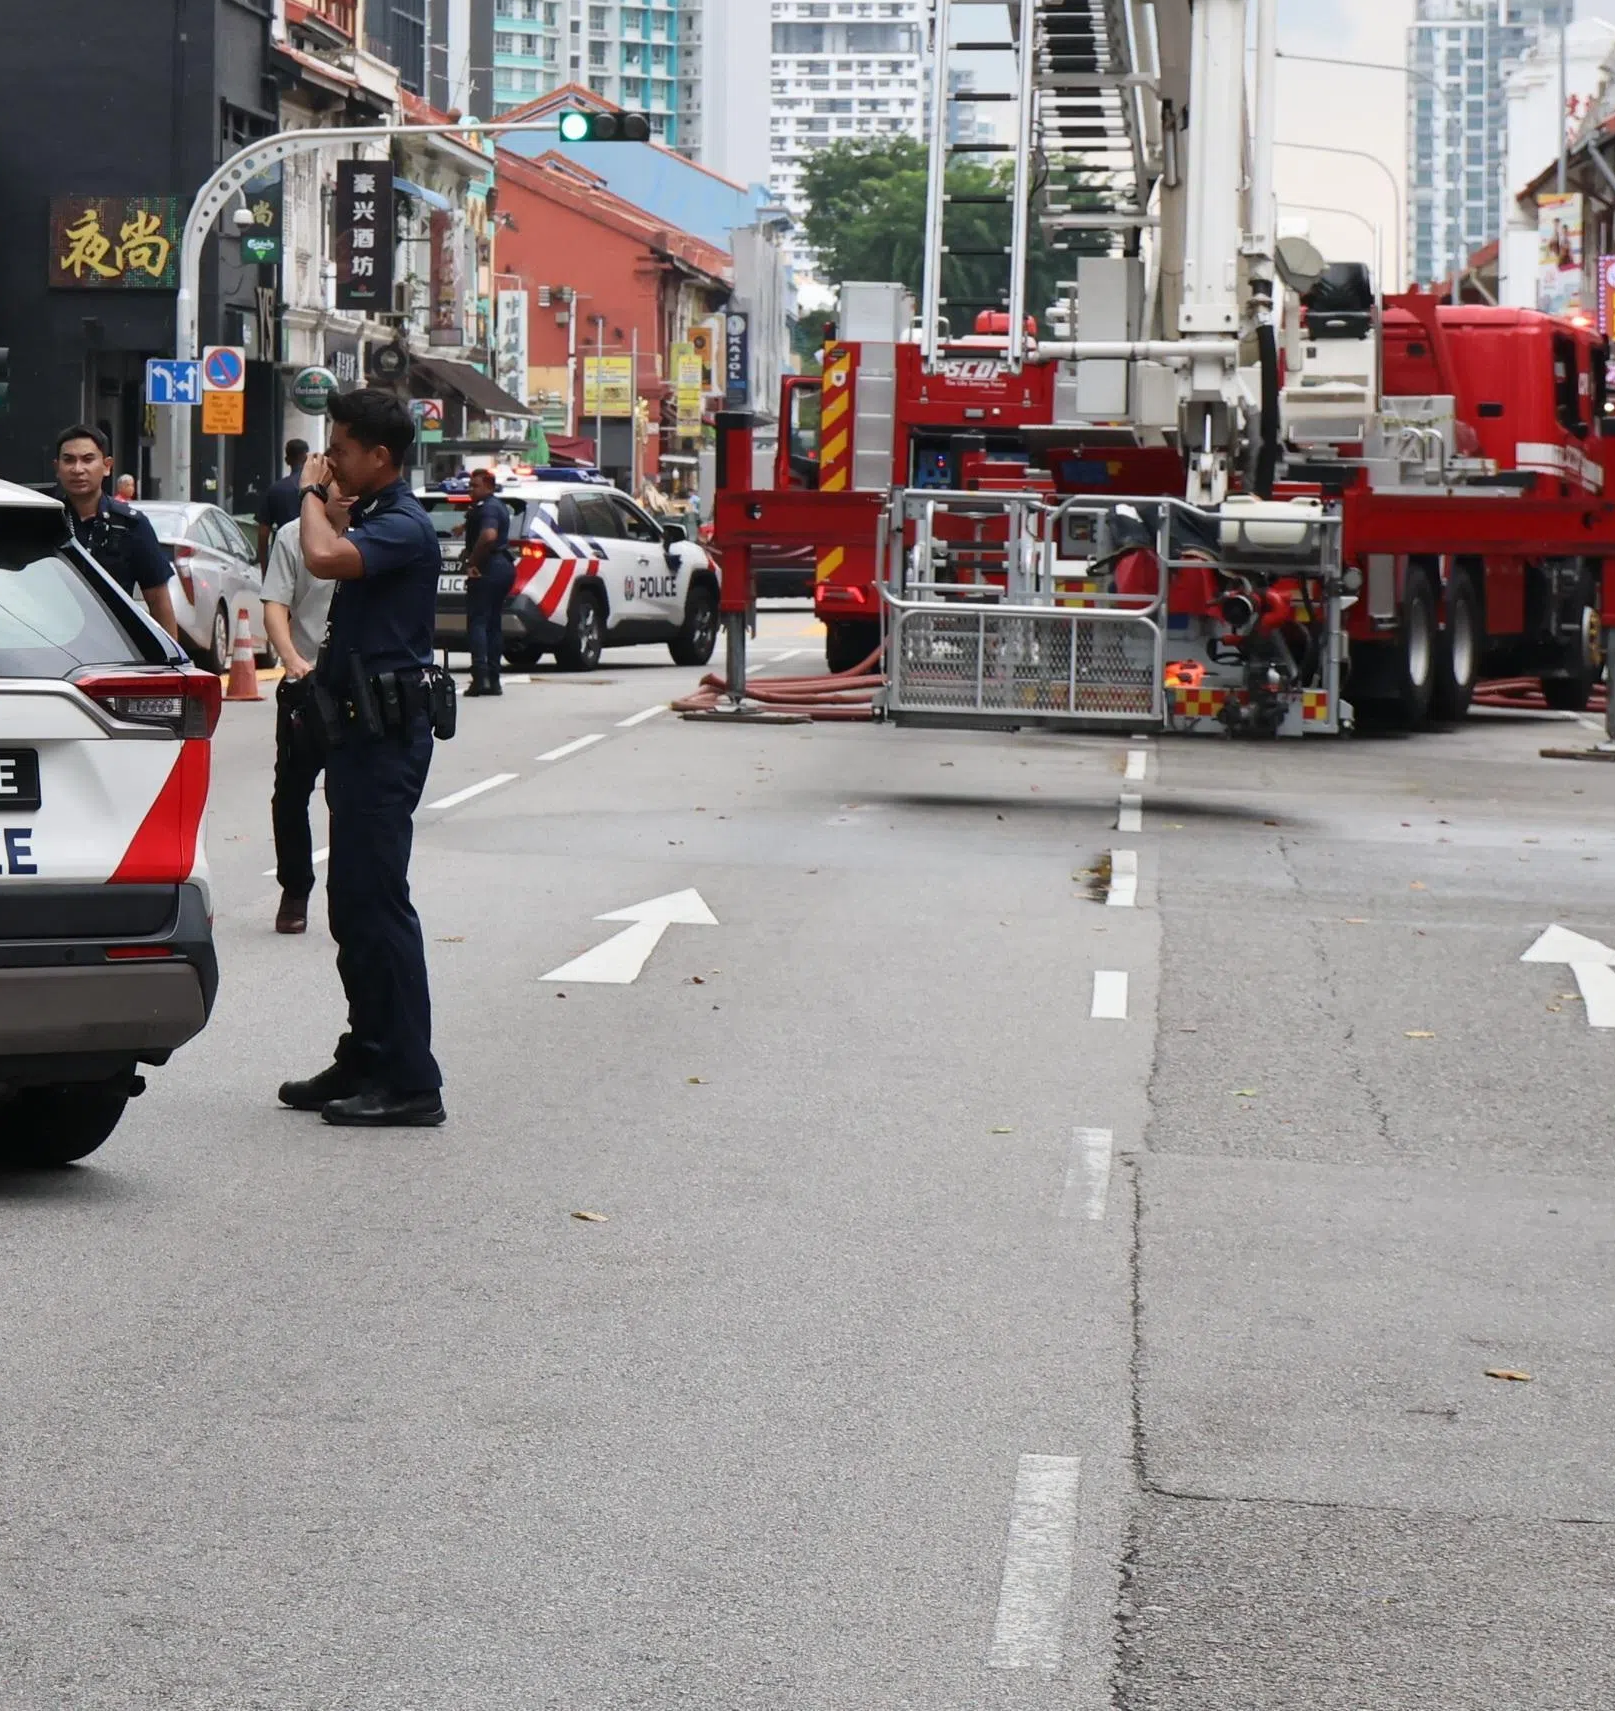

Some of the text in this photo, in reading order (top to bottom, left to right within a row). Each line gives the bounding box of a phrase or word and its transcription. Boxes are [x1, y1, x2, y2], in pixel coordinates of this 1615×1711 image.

[61, 209, 170, 278] 夜尚
[351, 173, 376, 277] 豪兴酒坊
[639, 576, 677, 599] POLICE
